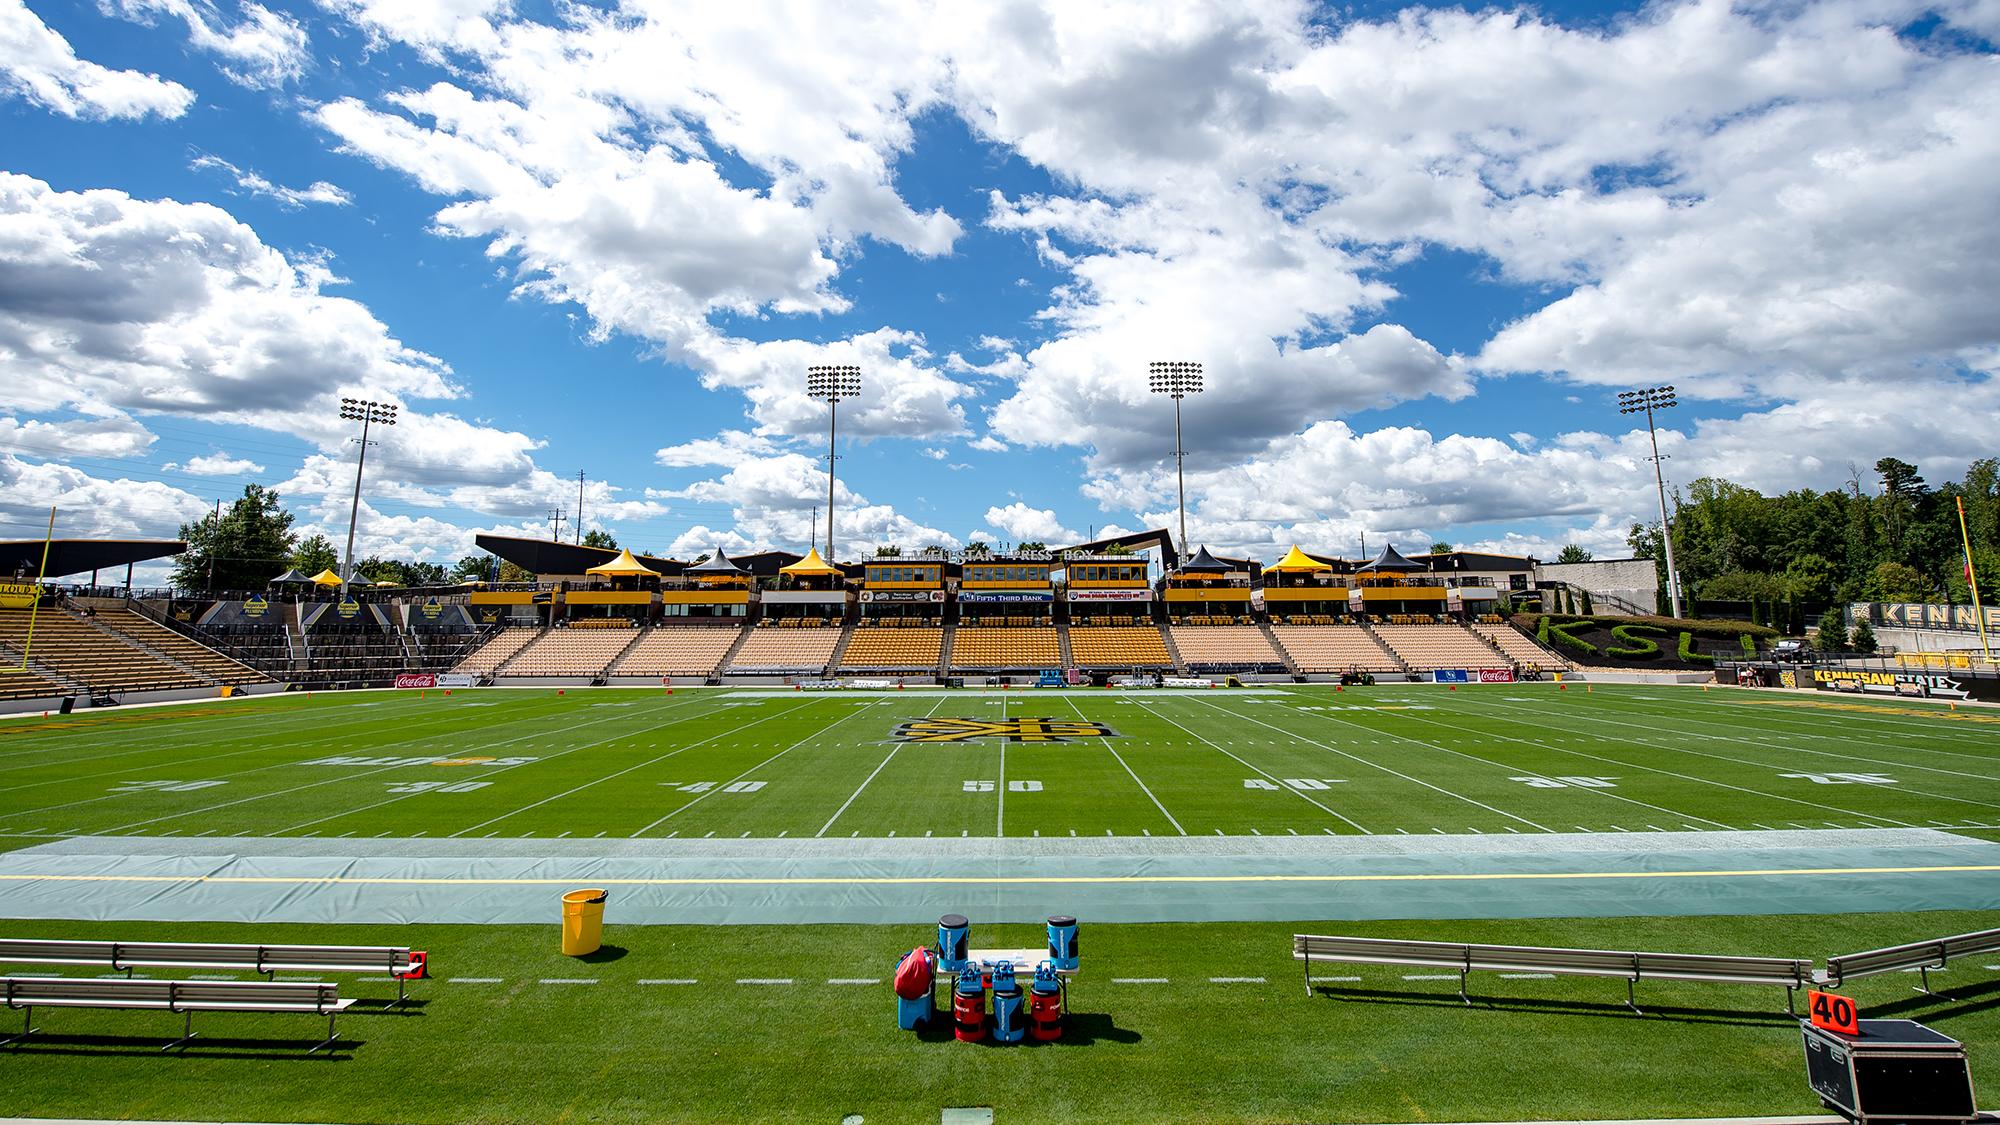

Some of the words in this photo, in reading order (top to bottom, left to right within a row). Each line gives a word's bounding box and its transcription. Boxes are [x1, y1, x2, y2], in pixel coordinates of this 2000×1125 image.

[1012, 549, 1053, 561] PRESS
[1063, 549, 1095, 561] BOX
[1537, 616, 1757, 663] KSU
[1814, 670, 1895, 686] KENNESAW
[1895, 674, 1949, 689] STATE
[676, 781, 768, 793] 40
[962, 780, 1043, 792] 50
[1243, 779, 1331, 790] 40
[1813, 995, 1851, 1027] 40
